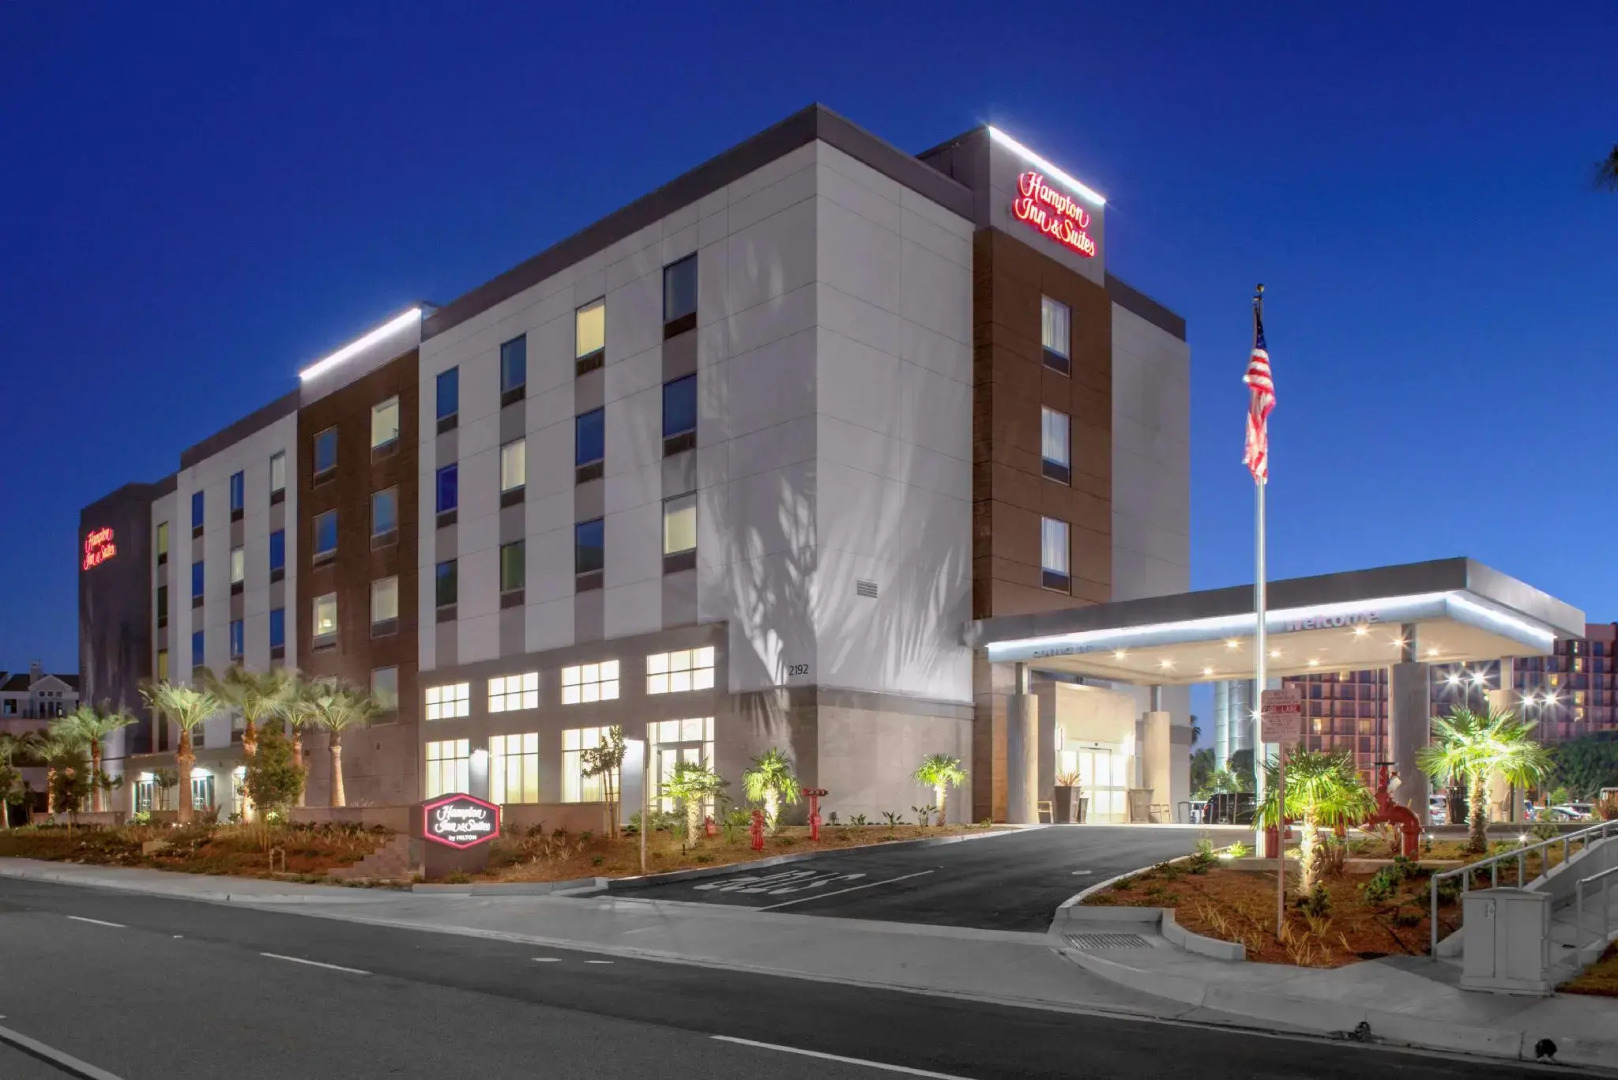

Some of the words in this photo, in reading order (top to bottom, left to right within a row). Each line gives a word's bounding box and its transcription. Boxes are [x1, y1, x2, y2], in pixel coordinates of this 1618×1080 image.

[1018, 170, 1090, 228] Hampton
[1014, 197, 1052, 232] Inn
[1050, 219, 1062, 239] &
[1059, 218, 1096, 257] Suites
[788, 663, 809, 676] 2192
[436, 805, 487, 821] Hampton
[434, 819, 460, 834] Inn
[464, 818, 491, 832] Suites
